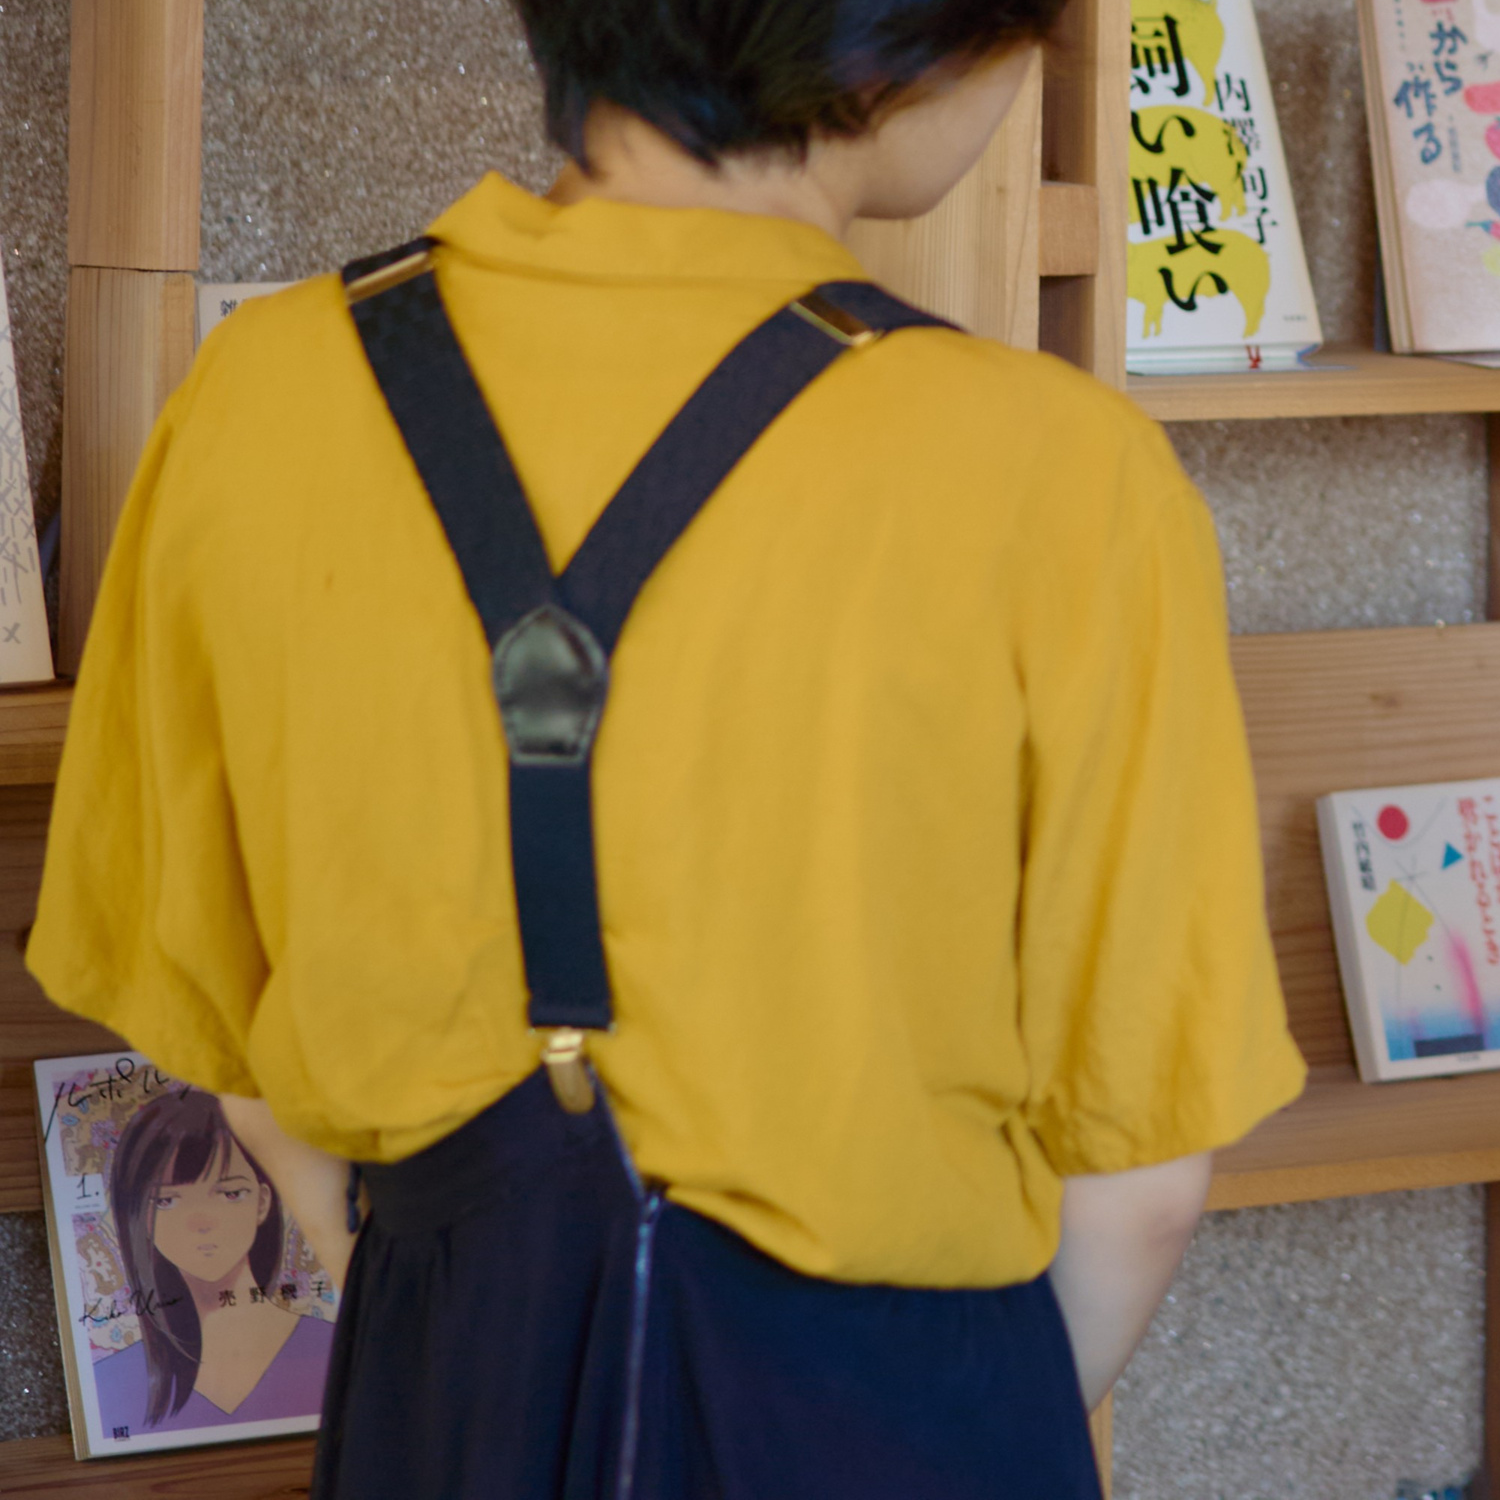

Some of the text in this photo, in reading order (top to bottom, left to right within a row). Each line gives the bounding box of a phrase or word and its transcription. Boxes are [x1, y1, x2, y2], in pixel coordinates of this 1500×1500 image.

[1131, 13, 1229, 312] 飼い喰い
[1394, 76, 1443, 164] 作る
[218, 1280, 328, 1307] 売野機子
